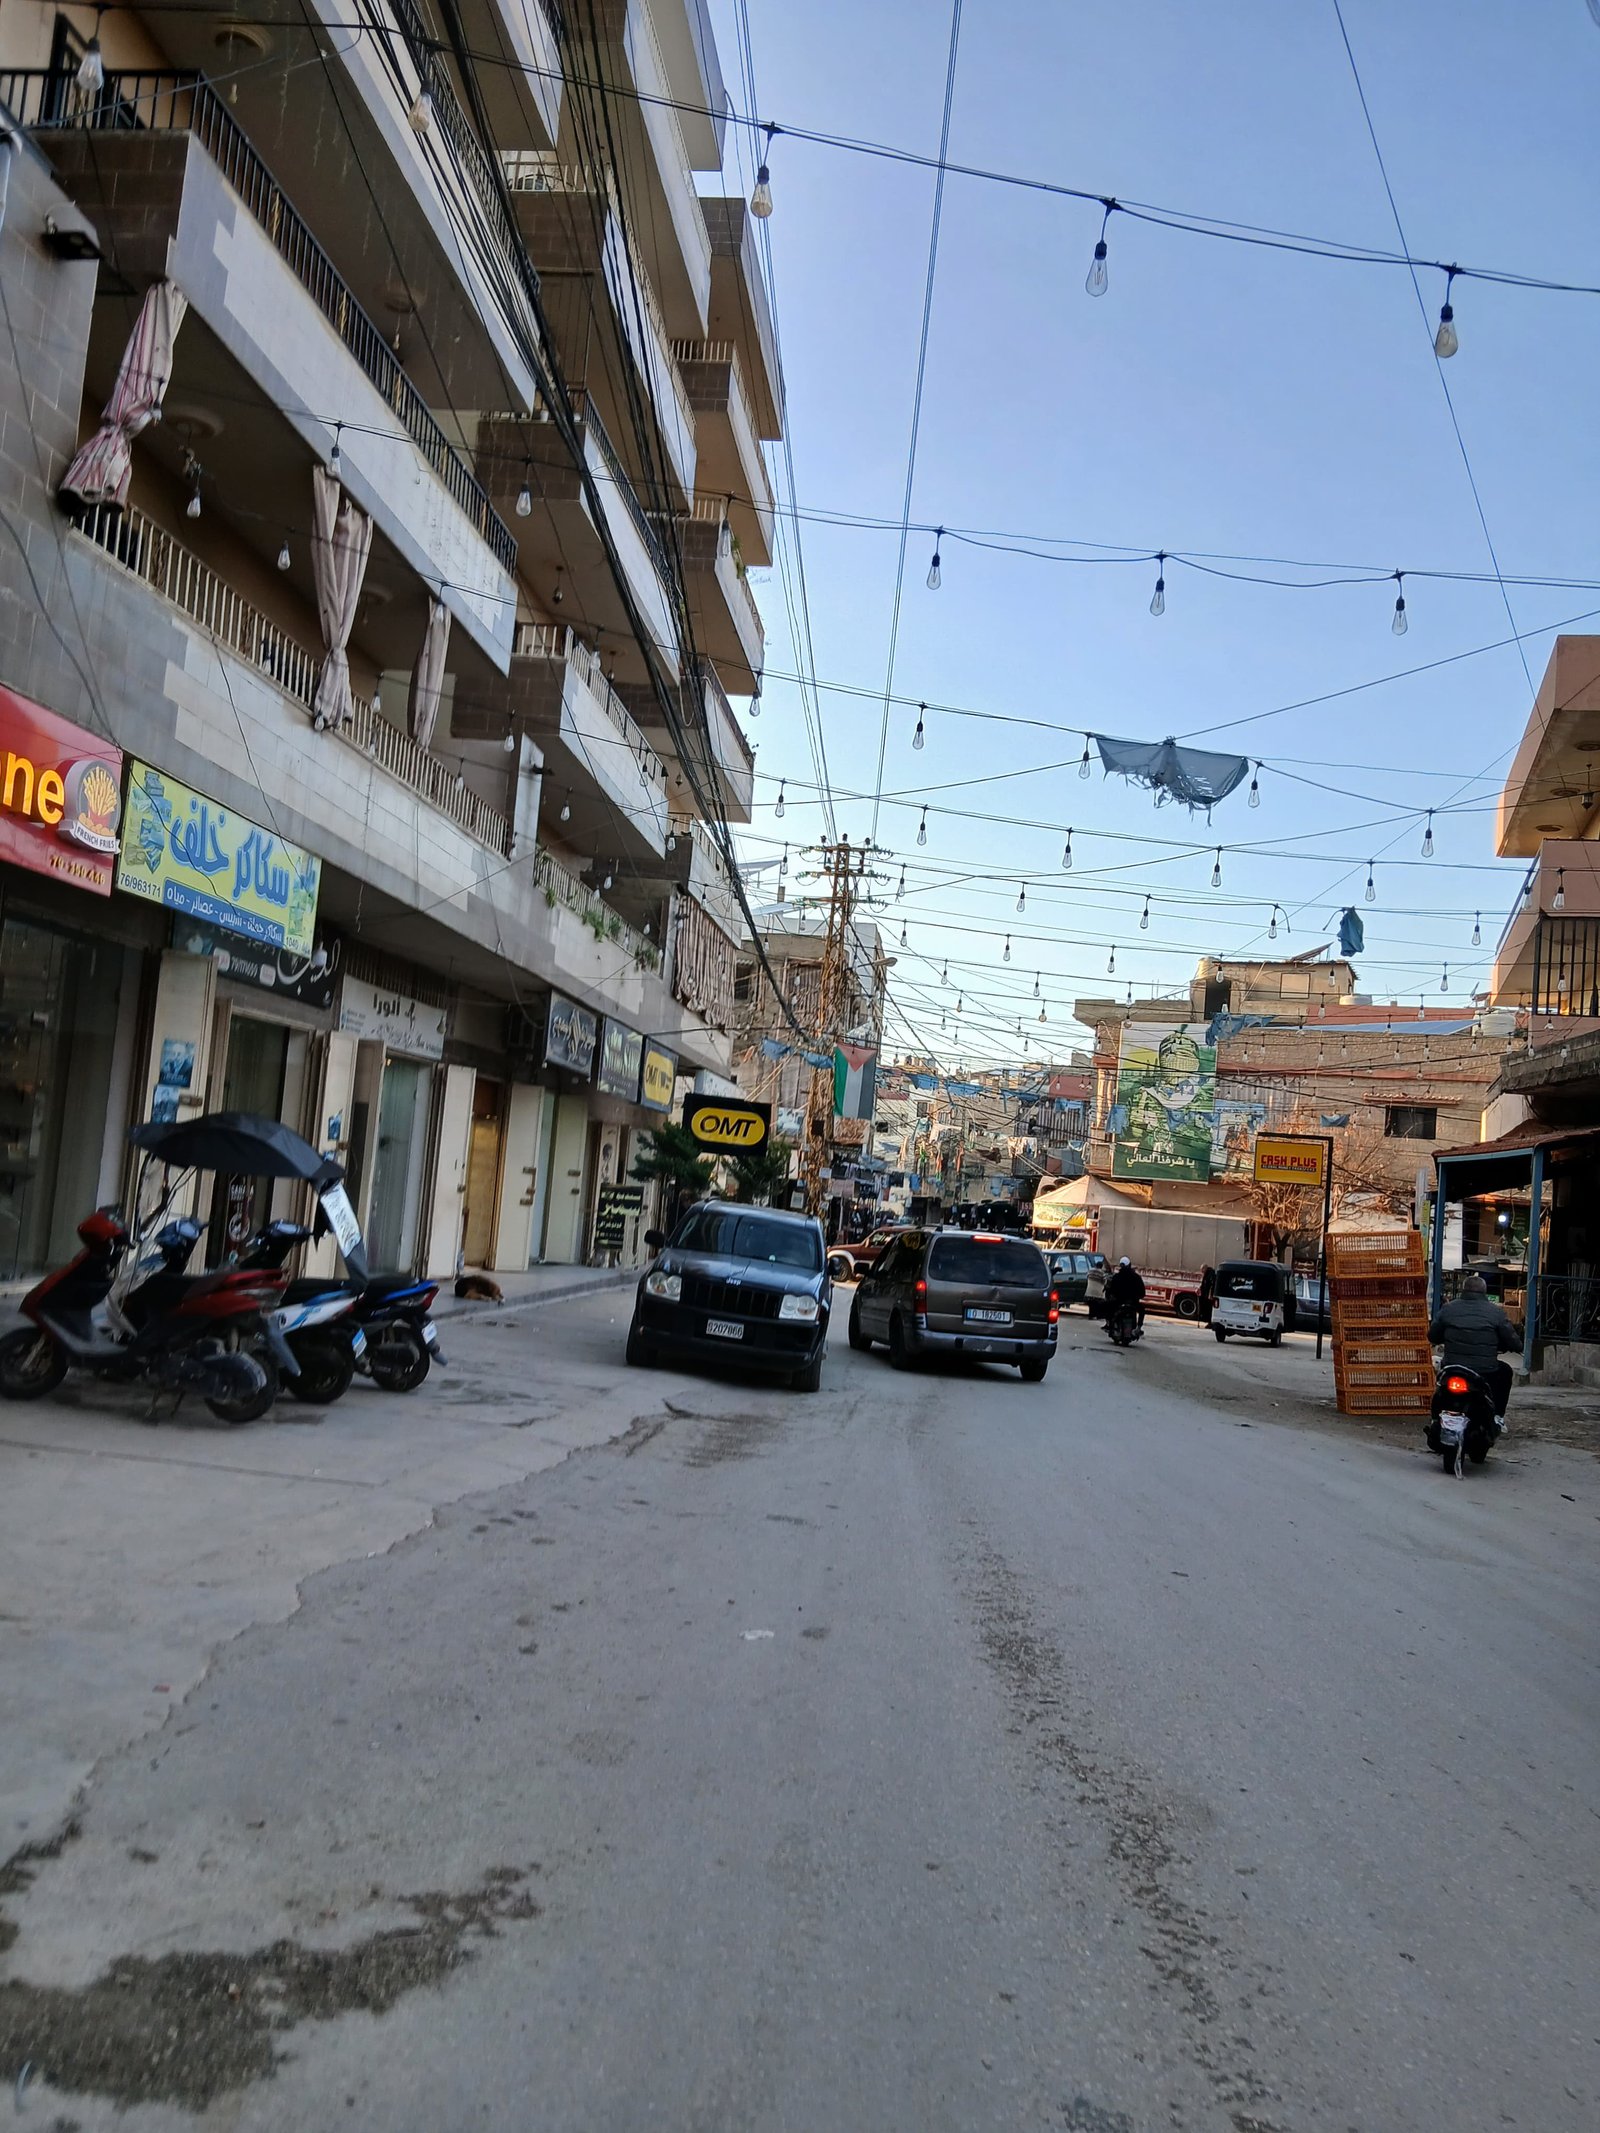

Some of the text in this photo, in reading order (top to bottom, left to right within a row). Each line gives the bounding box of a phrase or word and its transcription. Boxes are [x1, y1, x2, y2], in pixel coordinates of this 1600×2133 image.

[0, 751, 65, 824] ne
[76, 824, 115, 849] FRENCH FRIES
[170, 799, 289, 907] سكاكر خلف
[120, 872, 161, 898] 76/963171
[700, 1115, 756, 1138] OMT
[1261, 1154, 1317, 1168] CASH PLUS
